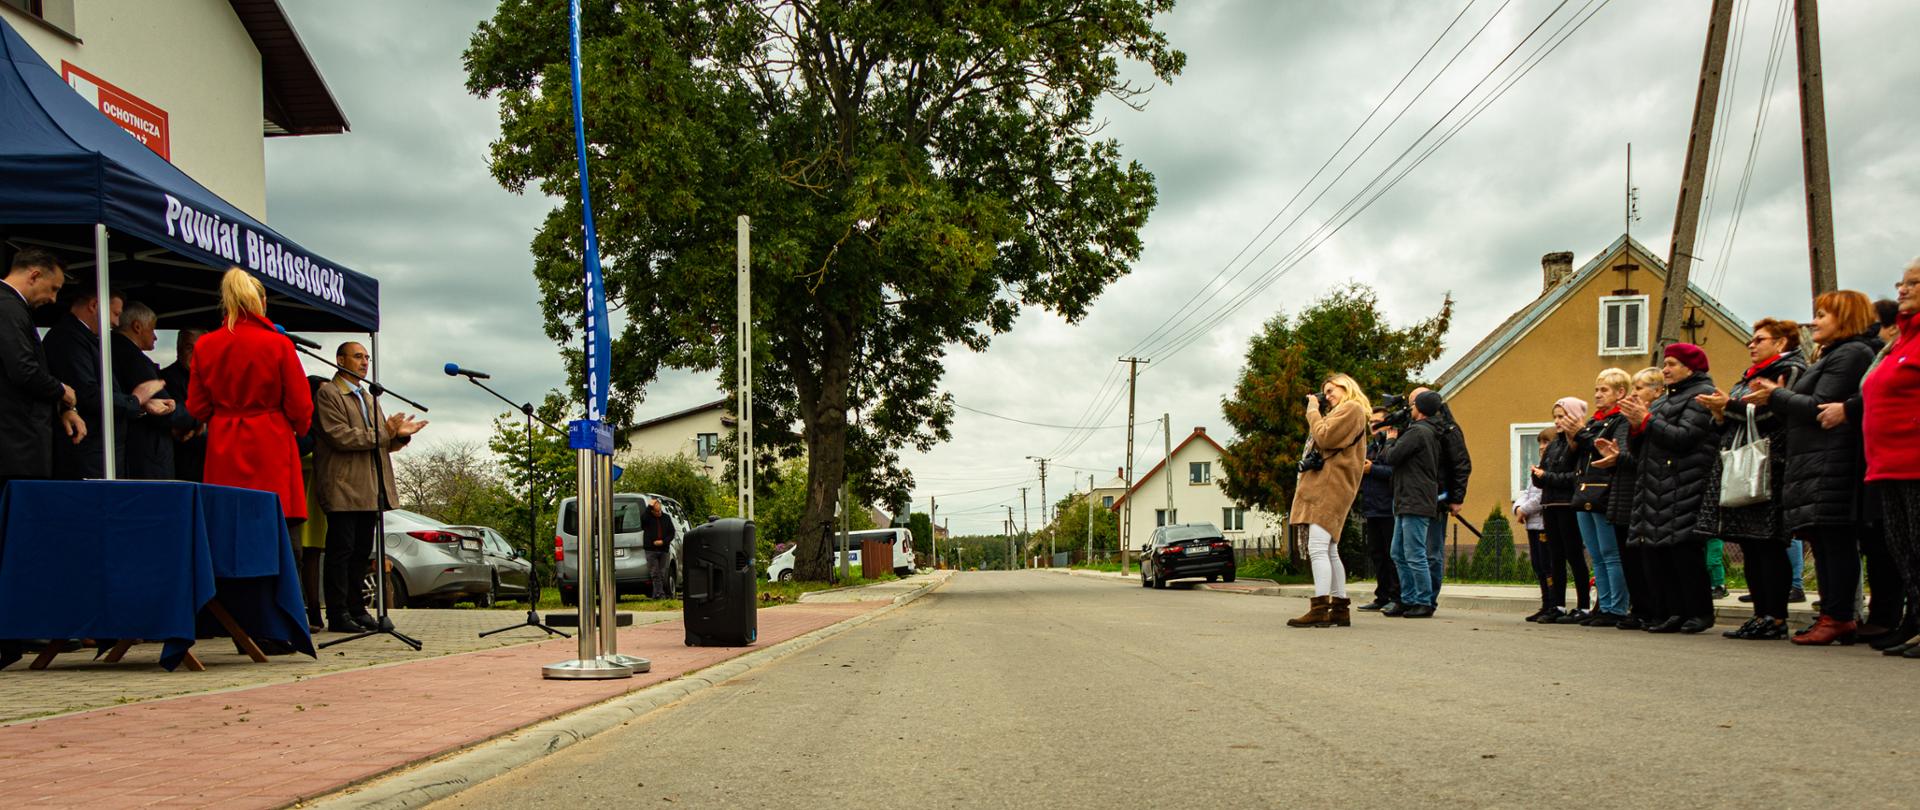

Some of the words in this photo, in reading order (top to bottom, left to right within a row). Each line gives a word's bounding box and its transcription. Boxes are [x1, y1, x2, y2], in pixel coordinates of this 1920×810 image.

[103, 101, 161, 139] OCHOTNICZA
[164, 193, 241, 264] Powiat
[246, 228, 346, 307] Białostocki
